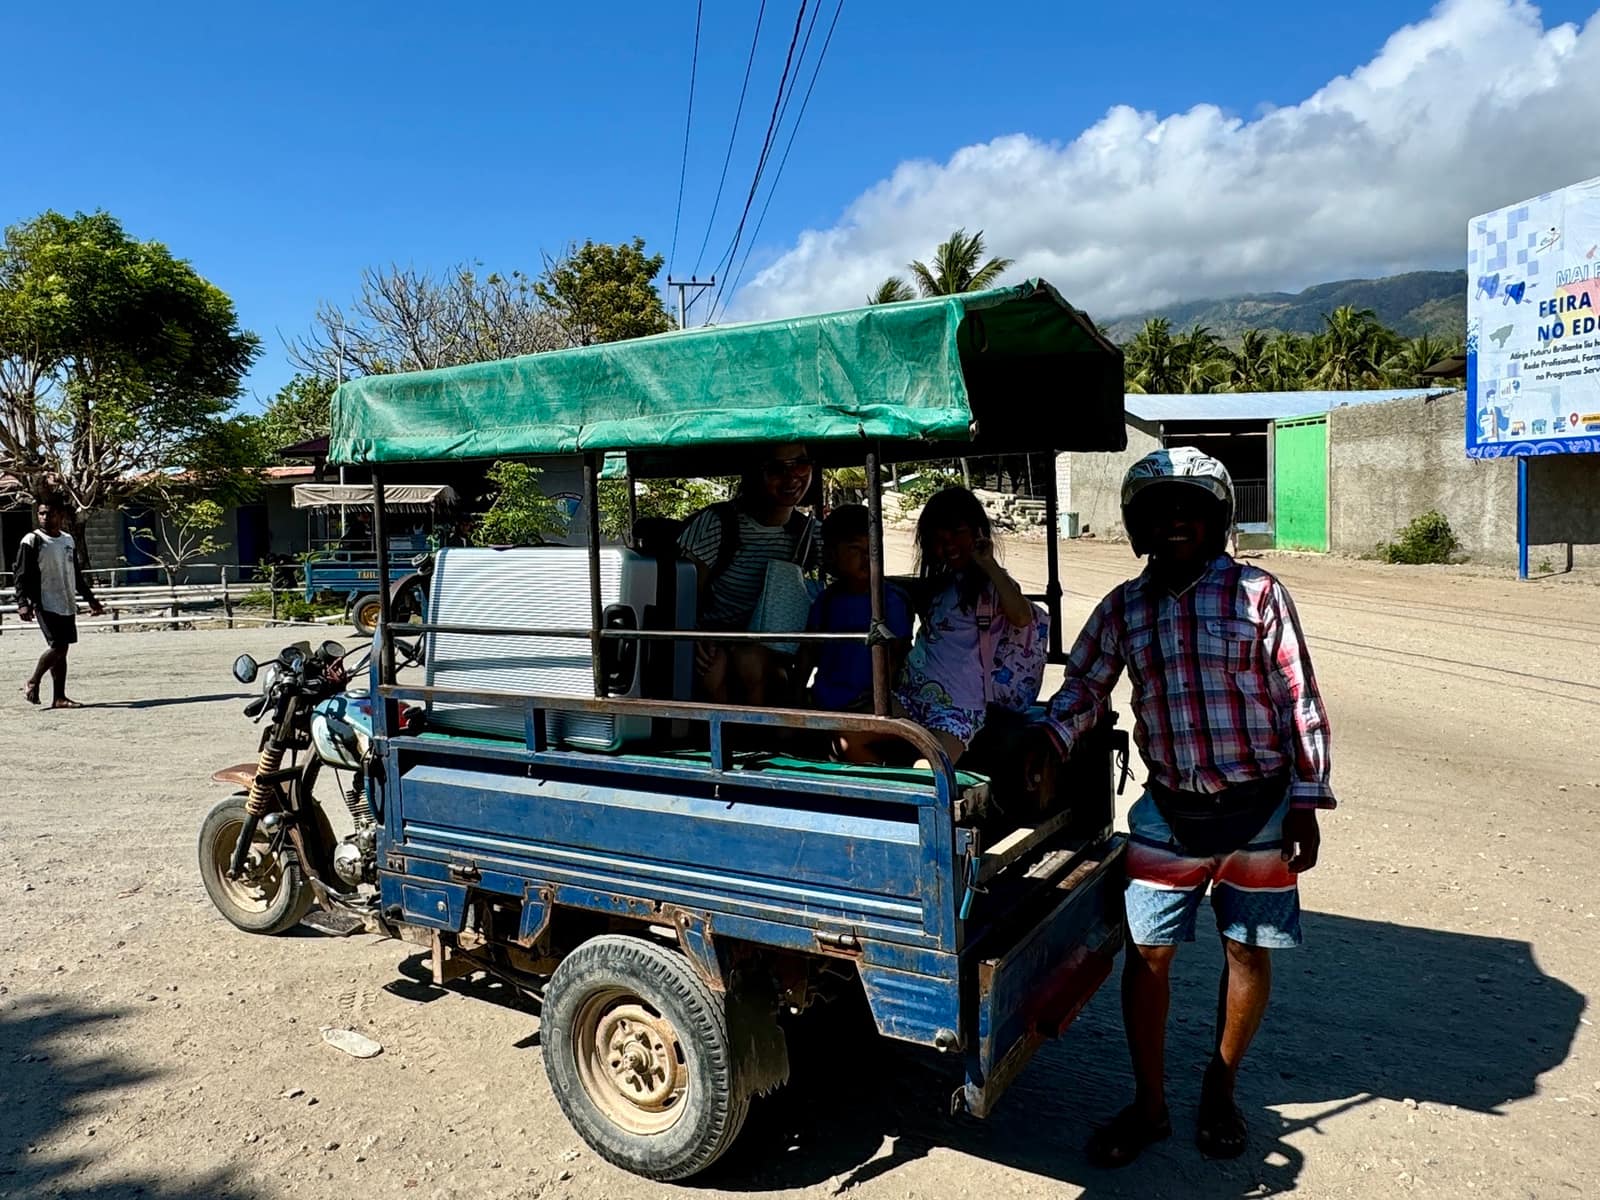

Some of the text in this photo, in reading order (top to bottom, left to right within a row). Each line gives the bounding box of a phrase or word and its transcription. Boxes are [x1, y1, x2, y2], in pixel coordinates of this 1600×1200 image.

[1556, 264, 1589, 288] MAI
[1539, 291, 1592, 317] FEIRA
[1538, 315, 1600, 342] NO ED
[1546, 369, 1582, 380] Programa
